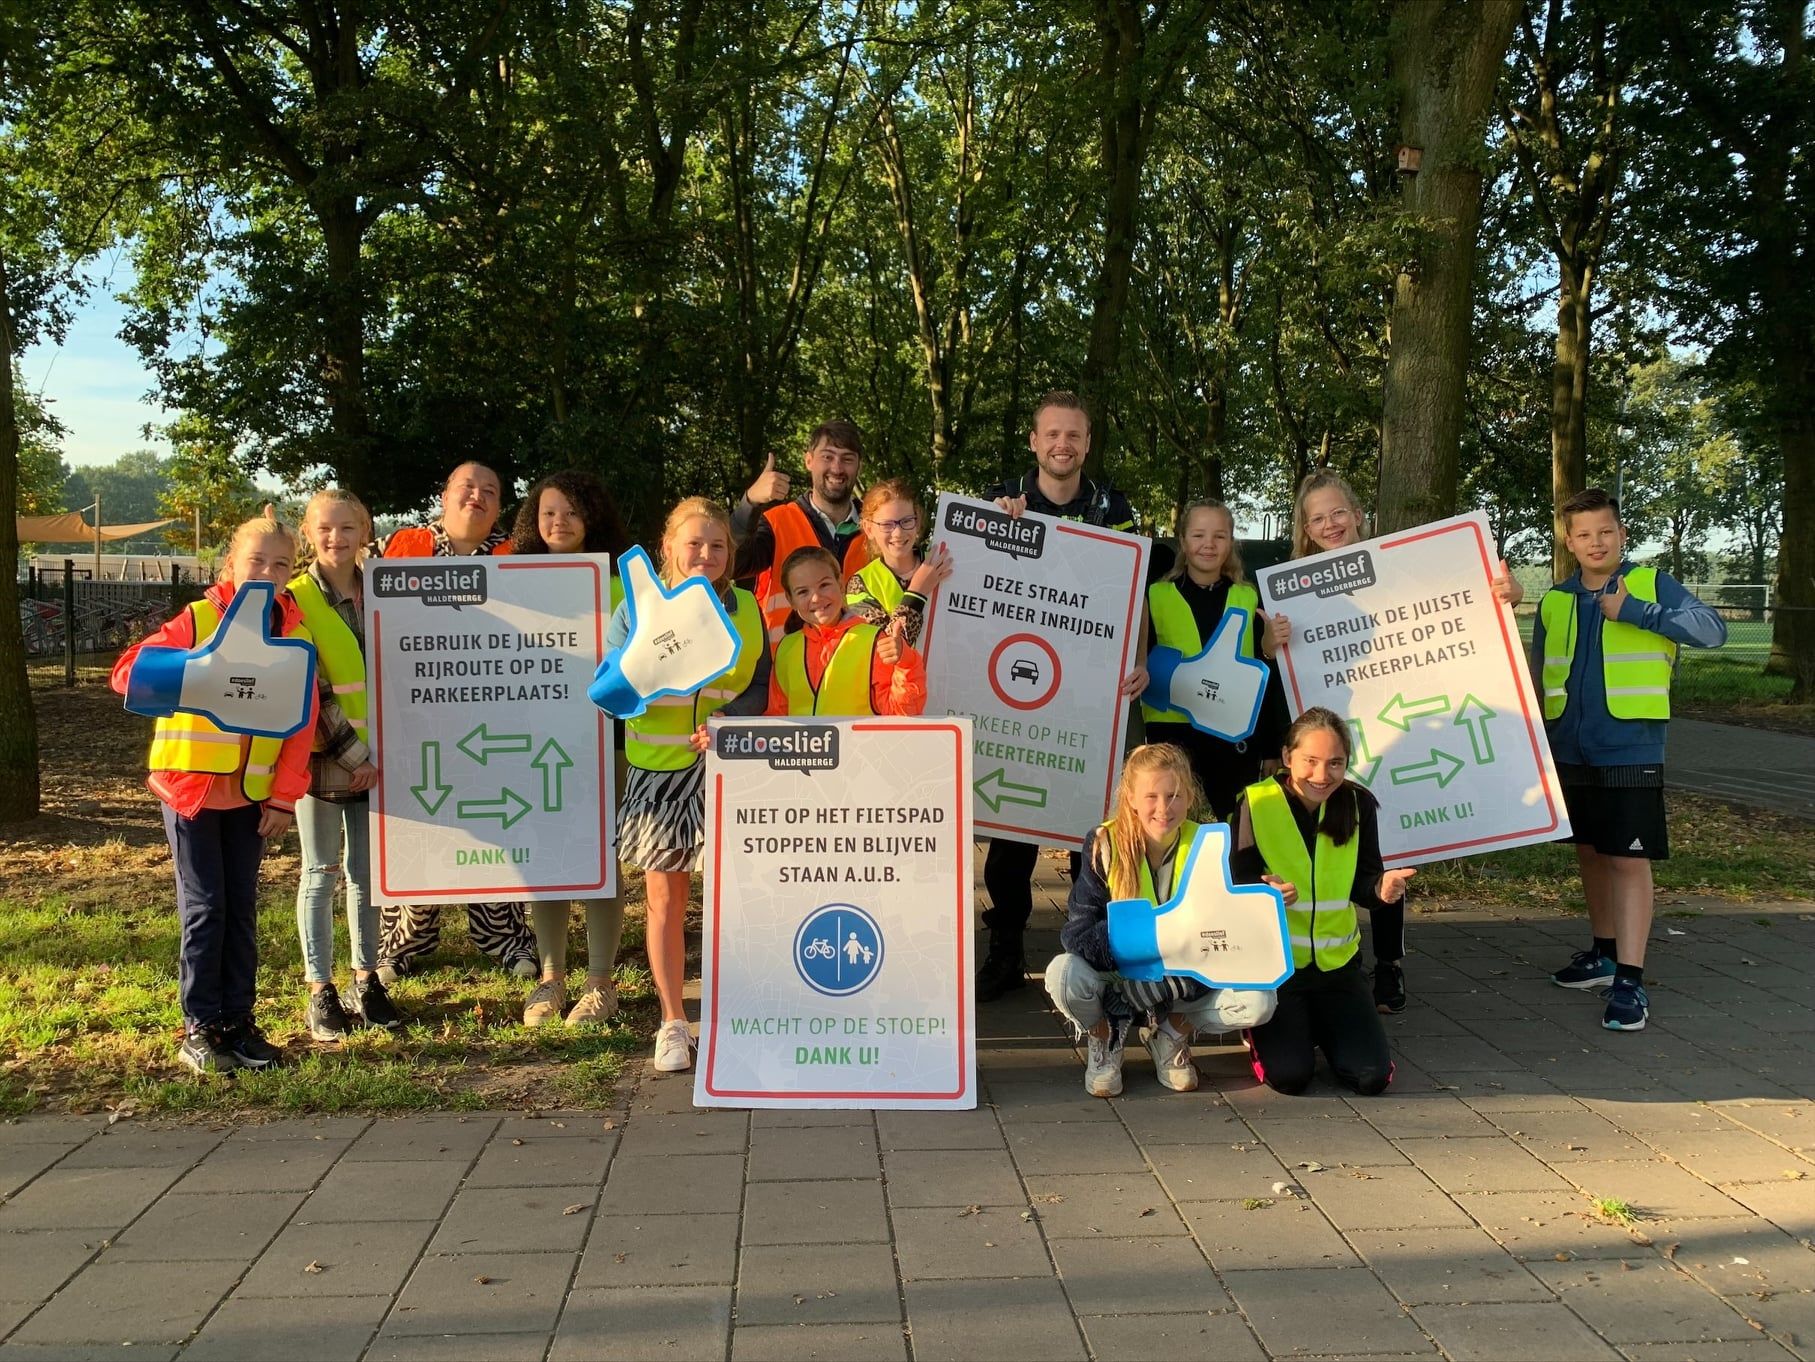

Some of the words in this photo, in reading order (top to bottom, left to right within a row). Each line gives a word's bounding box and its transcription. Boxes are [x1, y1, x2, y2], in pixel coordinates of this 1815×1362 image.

[951, 510, 1040, 544] #doeslief
[990, 539, 1037, 556] HALDERBERGE
[380, 570, 480, 591] #doeslief
[1275, 556, 1366, 594] #doeslief
[984, 575, 1023, 596] DEZE
[1028, 585, 1088, 609] STRAAT
[1321, 577, 1371, 596] HALDERBERGE
[427, 595, 482, 603] HALDERBERGE
[949, 592, 987, 613] NIET
[992, 602, 1035, 623] MEER
[1040, 612, 1114, 639] INRIJDEN
[1303, 612, 1381, 644] GEBRUIK
[1386, 607, 1408, 624] DE
[1414, 590, 1474, 619] JUISTE
[400, 635, 482, 651] GEBRUIK
[488, 634, 510, 649] DE
[517, 632, 578, 651] JUISTE
[1322, 633, 1406, 664] RIJROUTE
[1412, 625, 1435, 643] OP
[1443, 618, 1466, 635] DE
[415, 661, 503, 680] RIJROUTE
[510, 659, 534, 674] OP
[542, 659, 564, 673] DE
[1324, 640, 1476, 688] PARKEERPLAATS!
[411, 685, 569, 704] PARKEERPLAATS!
[947, 709, 1021, 736] RKEER
[1028, 725, 1050, 741] OP
[1058, 730, 1088, 748] HET
[725, 731, 833, 753] #doeslief
[774, 758, 833, 766] HALDERBERGE
[973, 740, 1085, 774] KEERTERREIN
[736, 809, 778, 824] NIET
[785, 809, 810, 824] OP
[816, 808, 849, 823] HET
[857, 808, 944, 823] FIETSPAD
[1400, 807, 1450, 829] DANK
[1455, 802, 1474, 819] U!
[456, 849, 506, 865] DANK
[512, 848, 530, 864] U!
[743, 838, 827, 853] STOPPEN
[834, 838, 856, 853] EN
[863, 837, 936, 856] BLIJVEN
[779, 867, 838, 882] STAAN
[845, 867, 900, 882] A.U.B.
[732, 1018, 801, 1035] WACHT
[809, 1018, 836, 1034] OP
[844, 1018, 868, 1034] DE
[876, 1017, 945, 1035] STOEP!
[795, 1047, 851, 1064] DANK
[858, 1047, 879, 1065] U!
